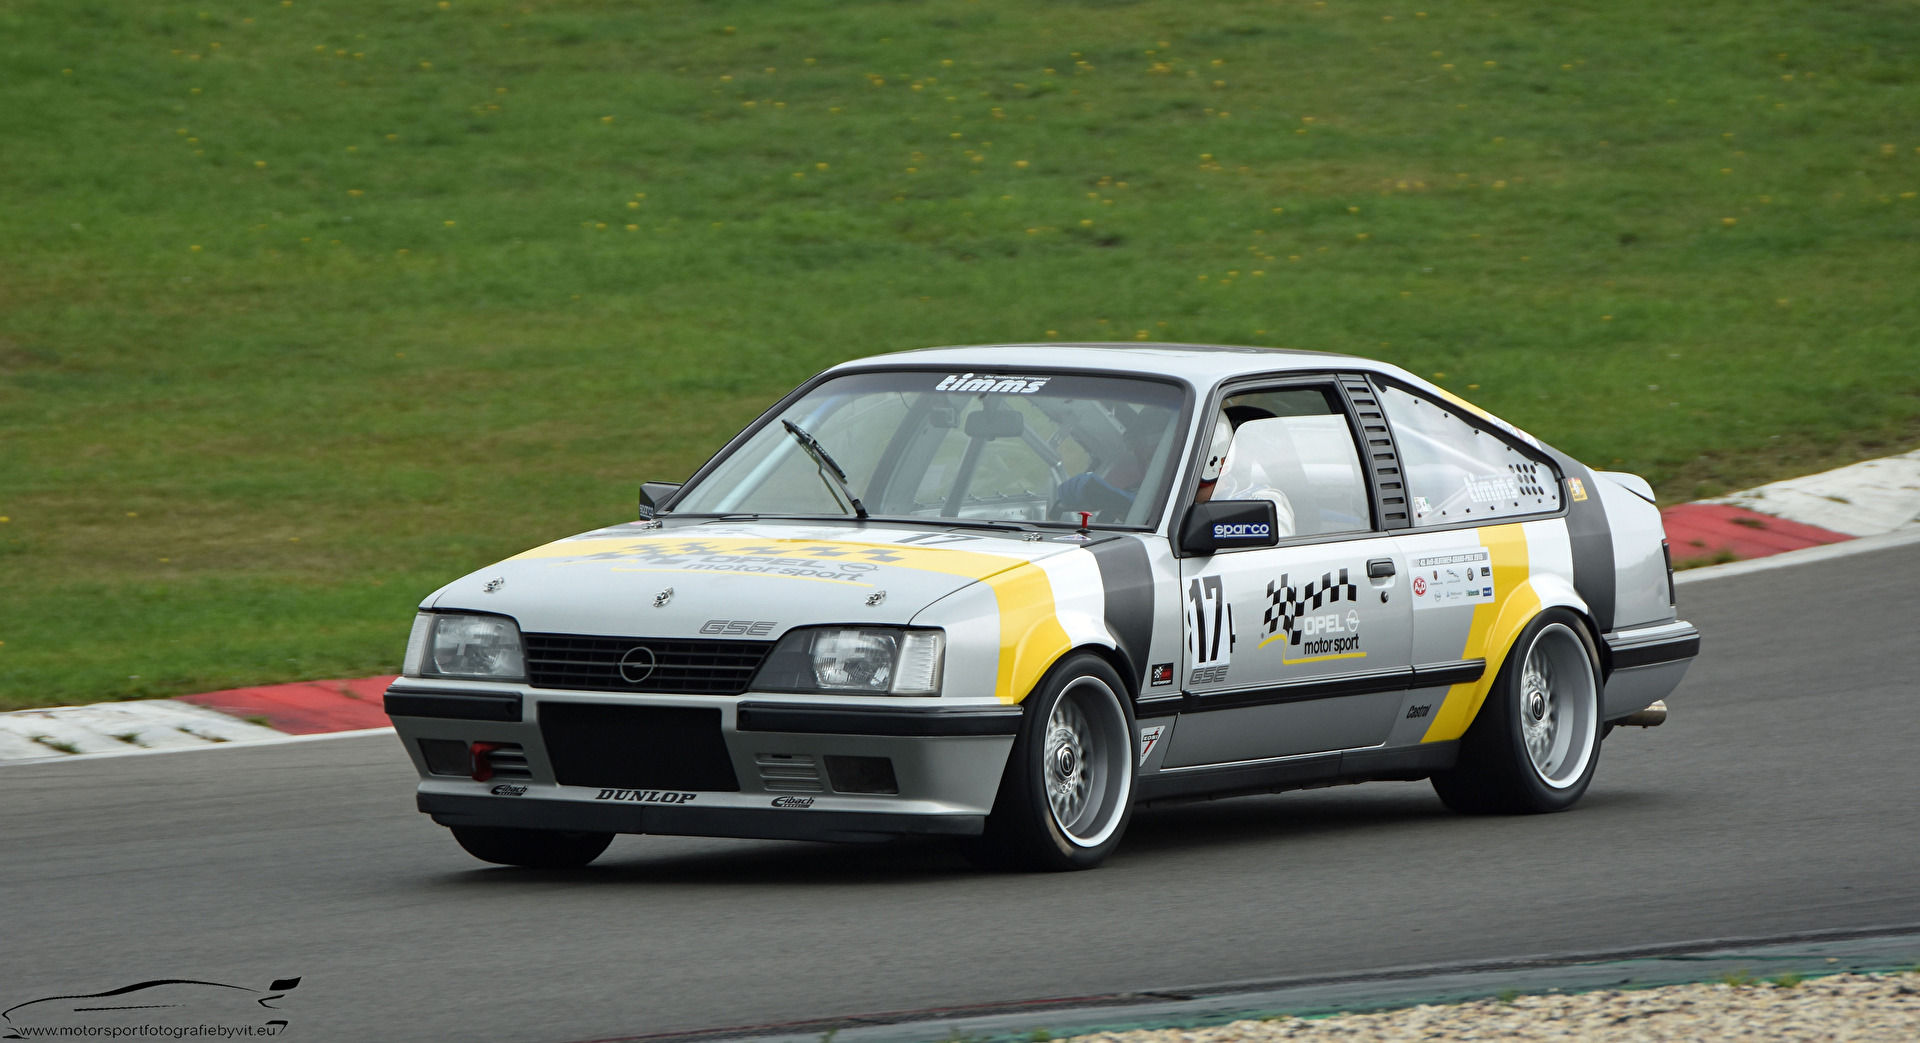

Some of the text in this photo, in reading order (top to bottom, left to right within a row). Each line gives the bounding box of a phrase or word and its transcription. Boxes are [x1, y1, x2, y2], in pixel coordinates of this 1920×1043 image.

[936, 373, 1047, 393] timms
[1463, 472, 1519, 503] timms
[1214, 524, 1270, 538] sparco
[894, 533, 983, 546] 17
[700, 555, 825, 568] OPEL
[1188, 575, 1223, 664] 17
[1304, 614, 1345, 635] OPEL
[699, 620, 778, 636] GSE
[1189, 665, 1230, 686] GSE
[1406, 704, 1432, 719] Castrol
[491, 784, 528, 795] Eibach
[595, 789, 698, 804] DUNLOP
[771, 796, 815, 807] Eibach
